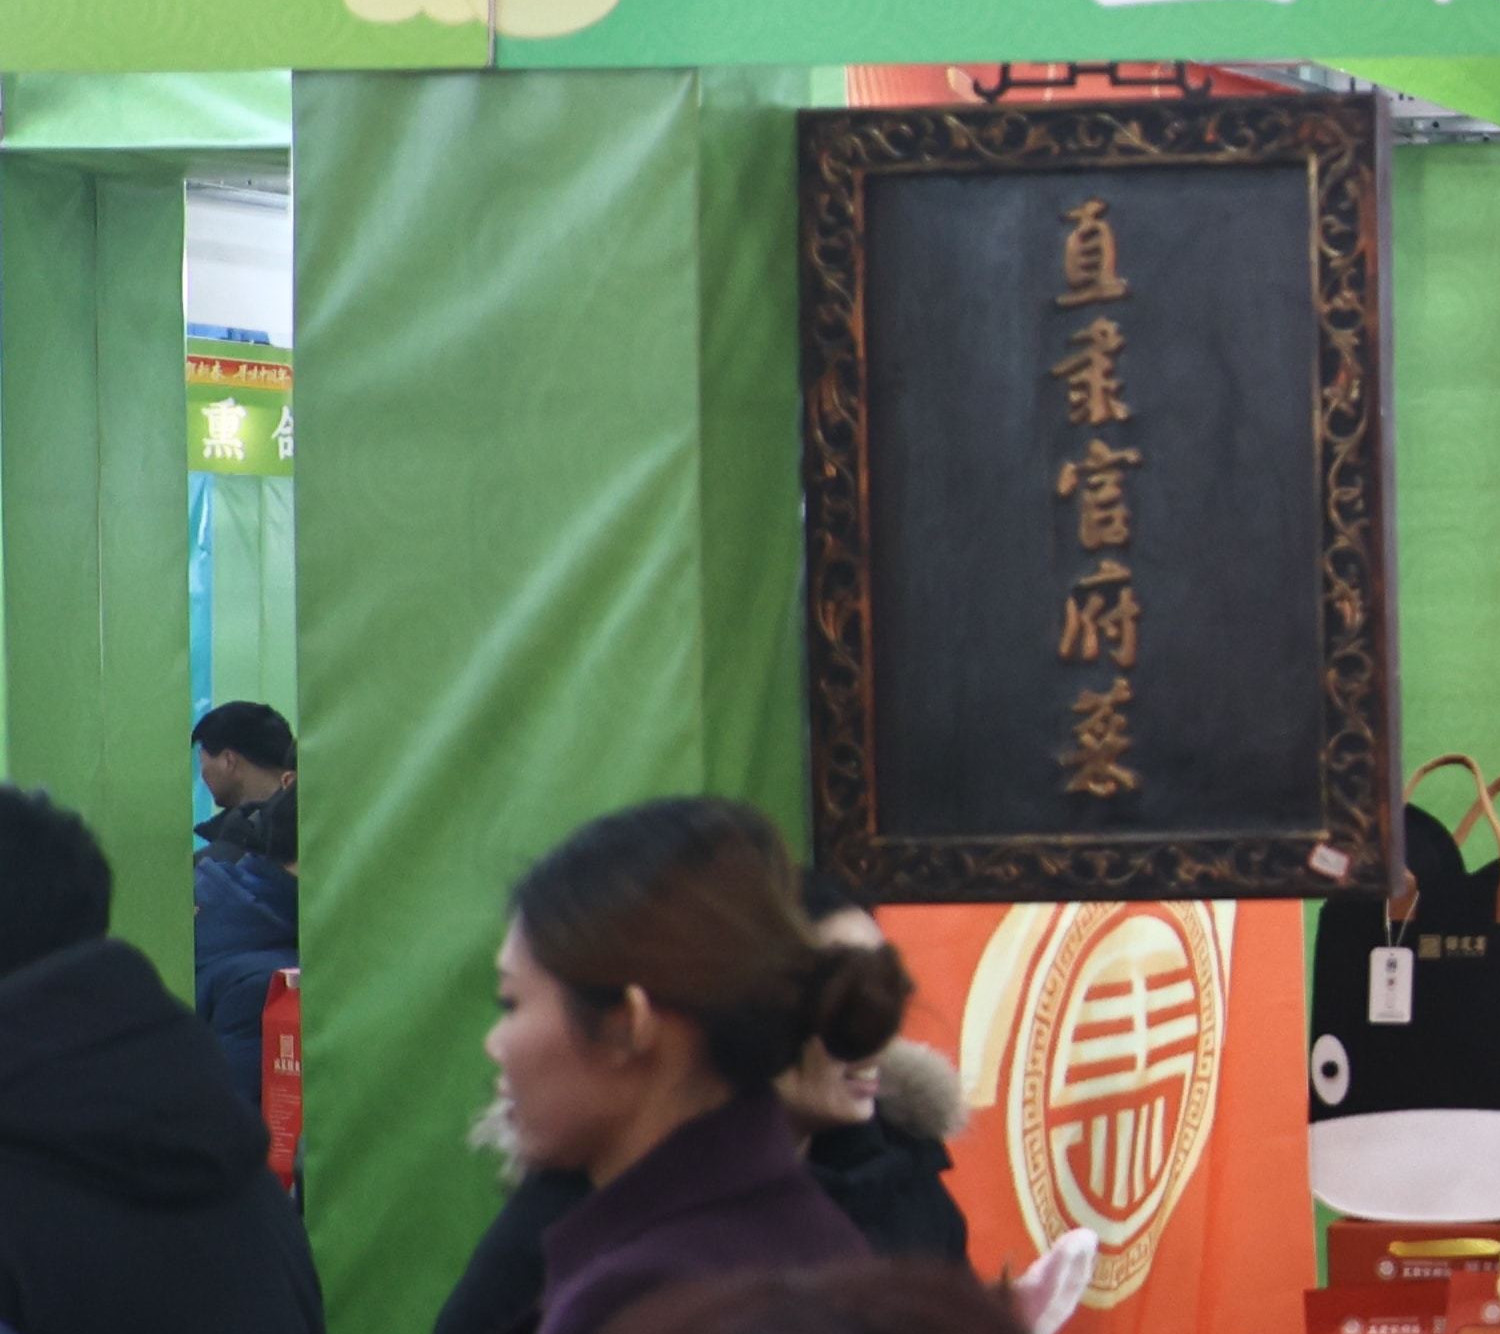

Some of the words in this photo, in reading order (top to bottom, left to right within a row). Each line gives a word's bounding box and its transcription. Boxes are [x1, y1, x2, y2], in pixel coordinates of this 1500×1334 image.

[1050, 197, 1144, 800] 直隶官府菜
